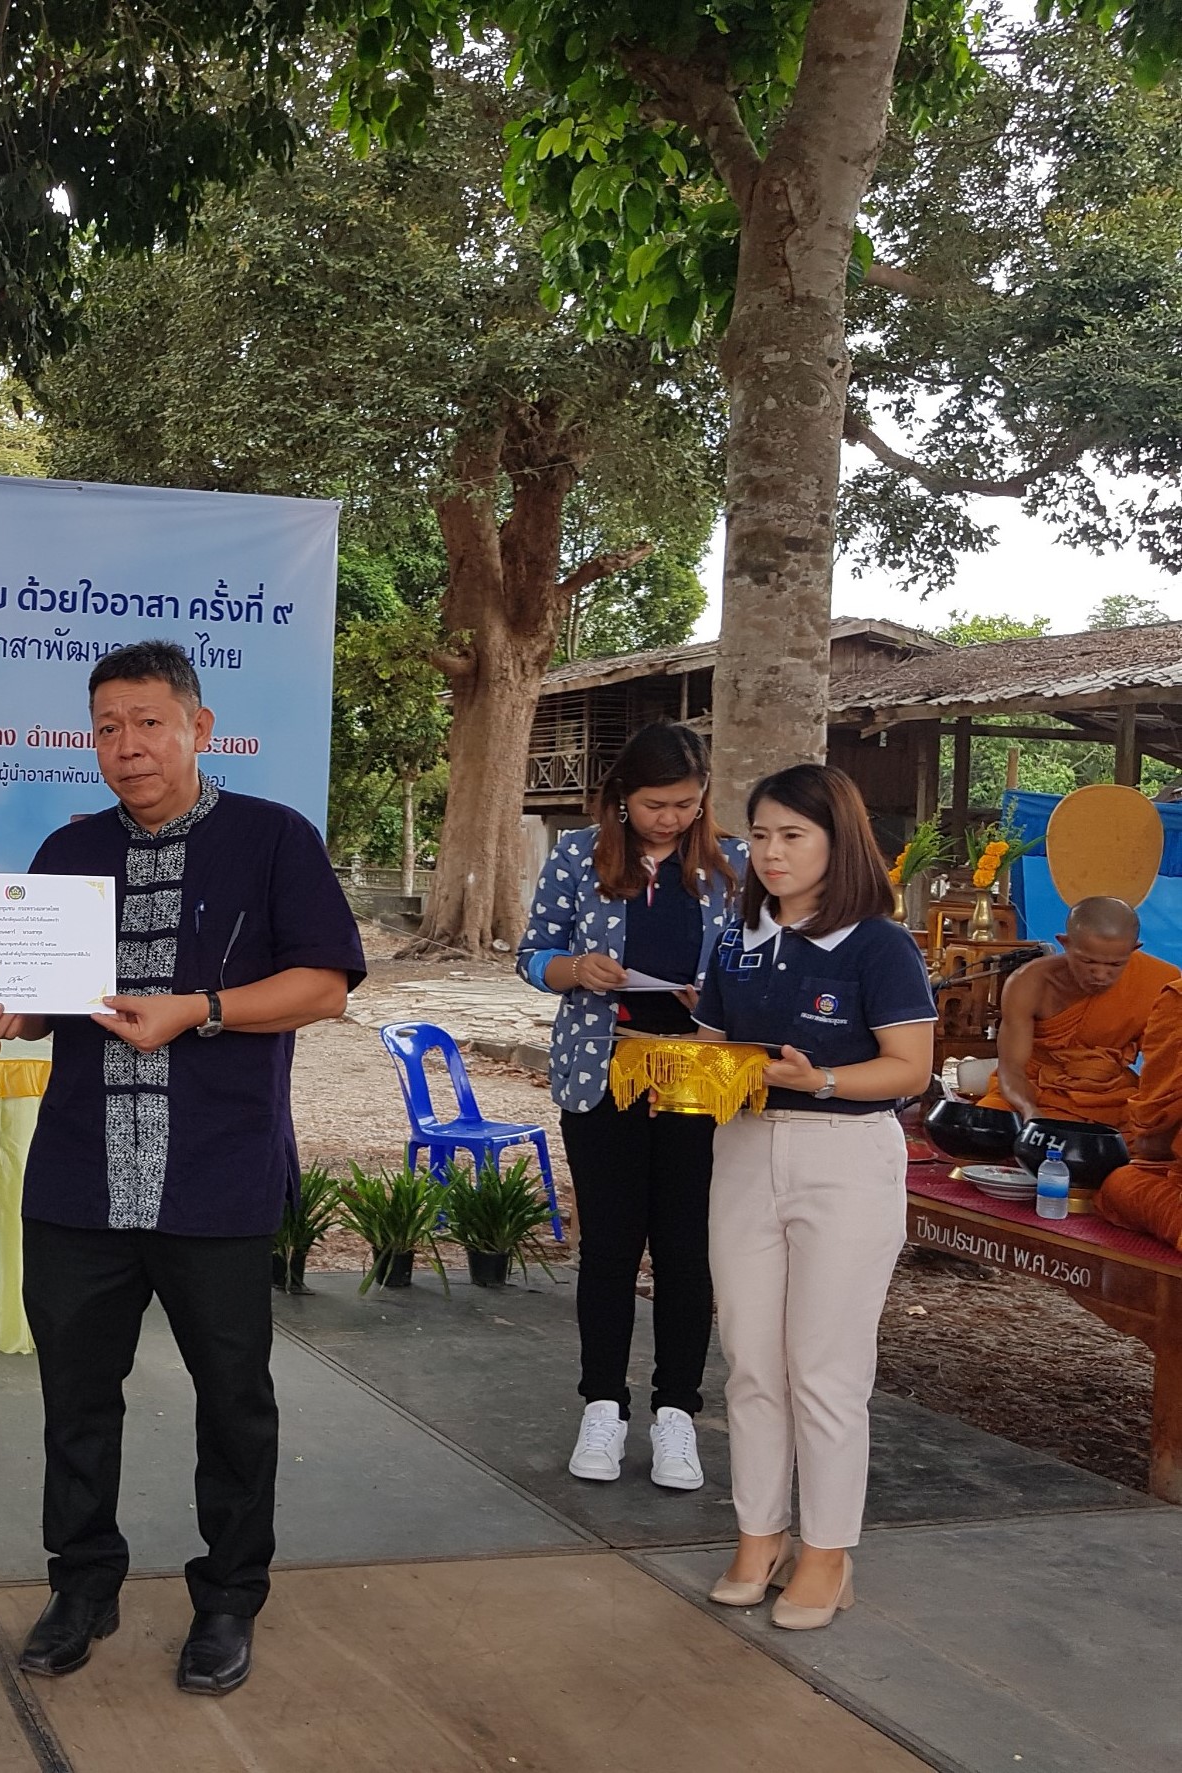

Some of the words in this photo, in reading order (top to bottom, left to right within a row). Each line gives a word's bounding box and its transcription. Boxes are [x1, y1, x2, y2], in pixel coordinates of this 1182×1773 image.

[18, 576, 180, 618] ด้วยใจอาสา
[189, 579, 264, 624] ครั้งที่
[273, 602, 294, 625] ๙
[1013, 1247, 1091, 1288] พ.ศ.2560
